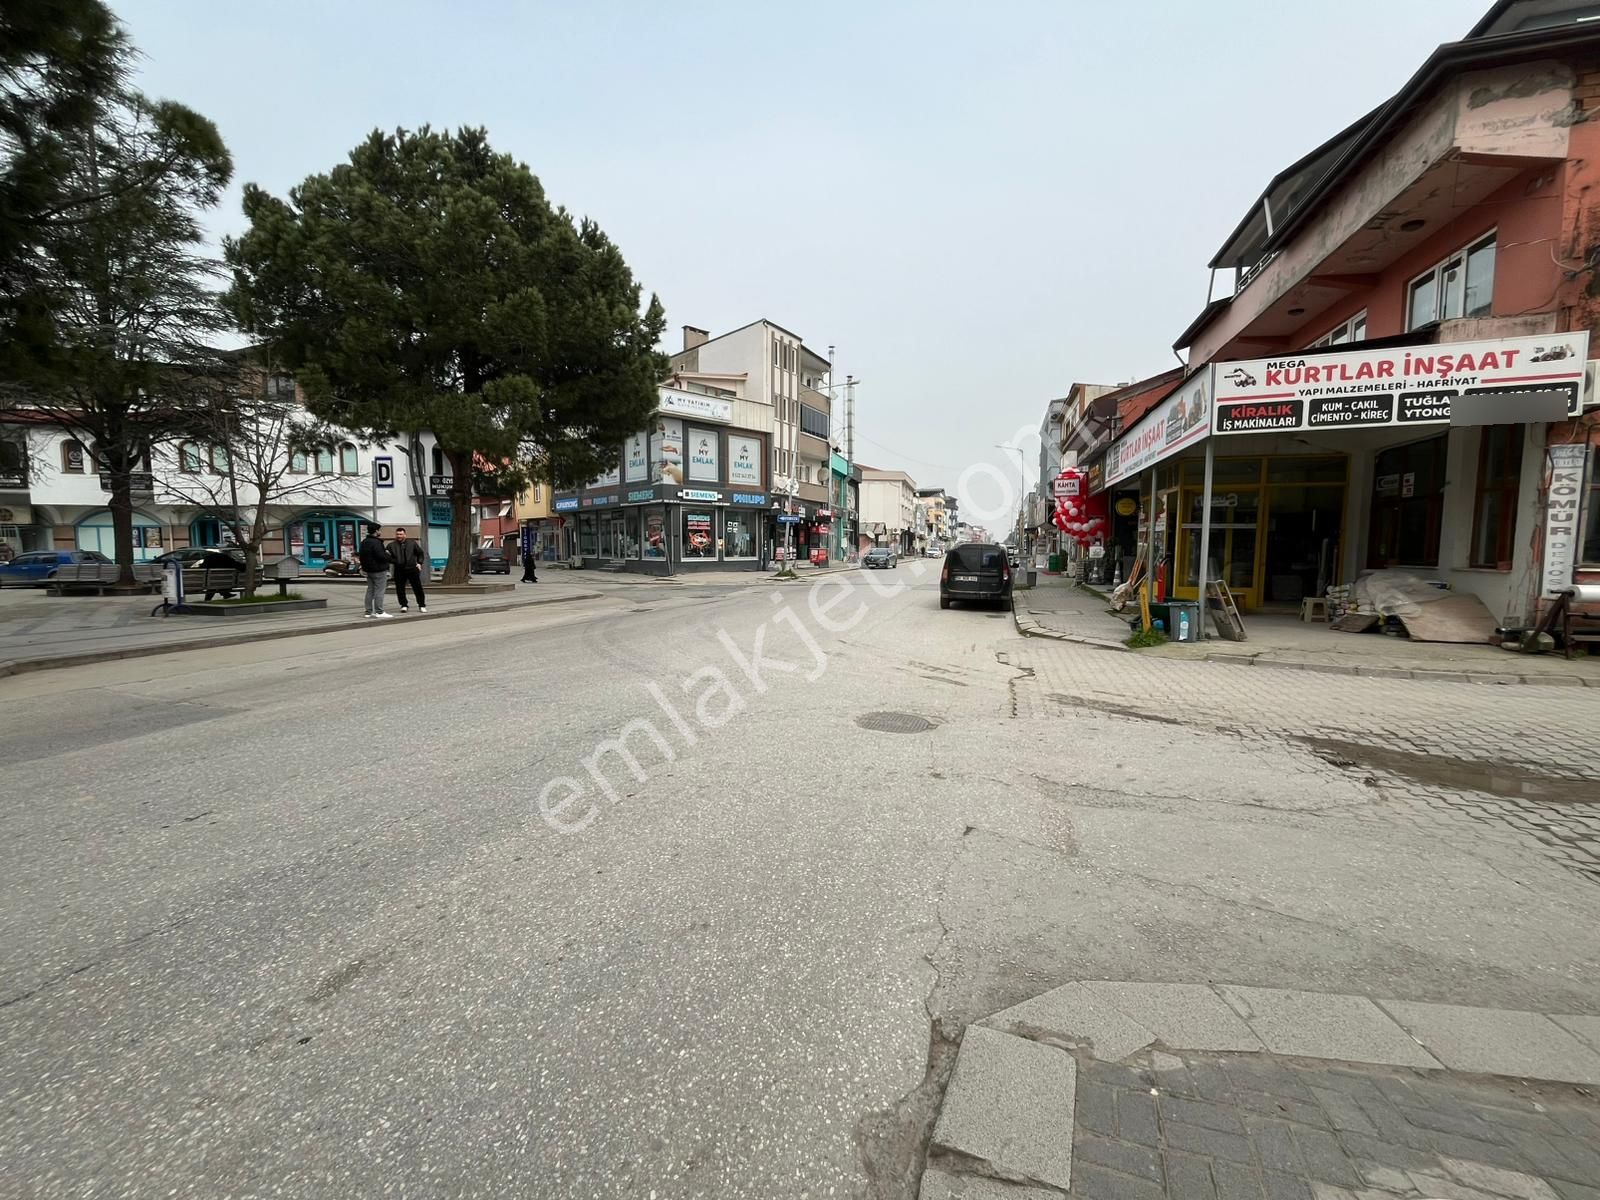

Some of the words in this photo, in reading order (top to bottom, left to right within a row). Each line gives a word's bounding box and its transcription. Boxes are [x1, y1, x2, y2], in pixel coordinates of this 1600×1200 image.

[1265, 360, 1394, 387] KURTLAR
[1403, 349, 1520, 379] İNŞAAT
[1267, 360, 1306, 370] MEGA
[1298, 387, 1323, 397] YAPI
[1326, 380, 1407, 394] MALZEMELERİ
[1417, 375, 1478, 388] HAFRİYAT
[1321, 402, 1343, 412] KUM
[1351, 400, 1379, 411] ÇAKIL
[1404, 394, 1450, 407] TUĞLA
[1231, 404, 1293, 418] KİRALIK
[1311, 411, 1352, 423] ÇİMENTO
[1360, 409, 1389, 420] KİREÇ
[1404, 407, 1450, 418] YTONG
[1223, 418, 1232, 431] İŞ
[1233, 416, 1296, 429] MAKİNALARI
[692, 456, 714, 465] EMLAK
[734, 461, 753, 469] EMLAK
[378, 463, 390, 482] D
[690, 490, 716, 499] SIEMENS
[733, 493, 766, 504] PHILIPS
[1548, 472, 1578, 536] KÖMÜR
[1547, 542, 1568, 597] DEPOS
